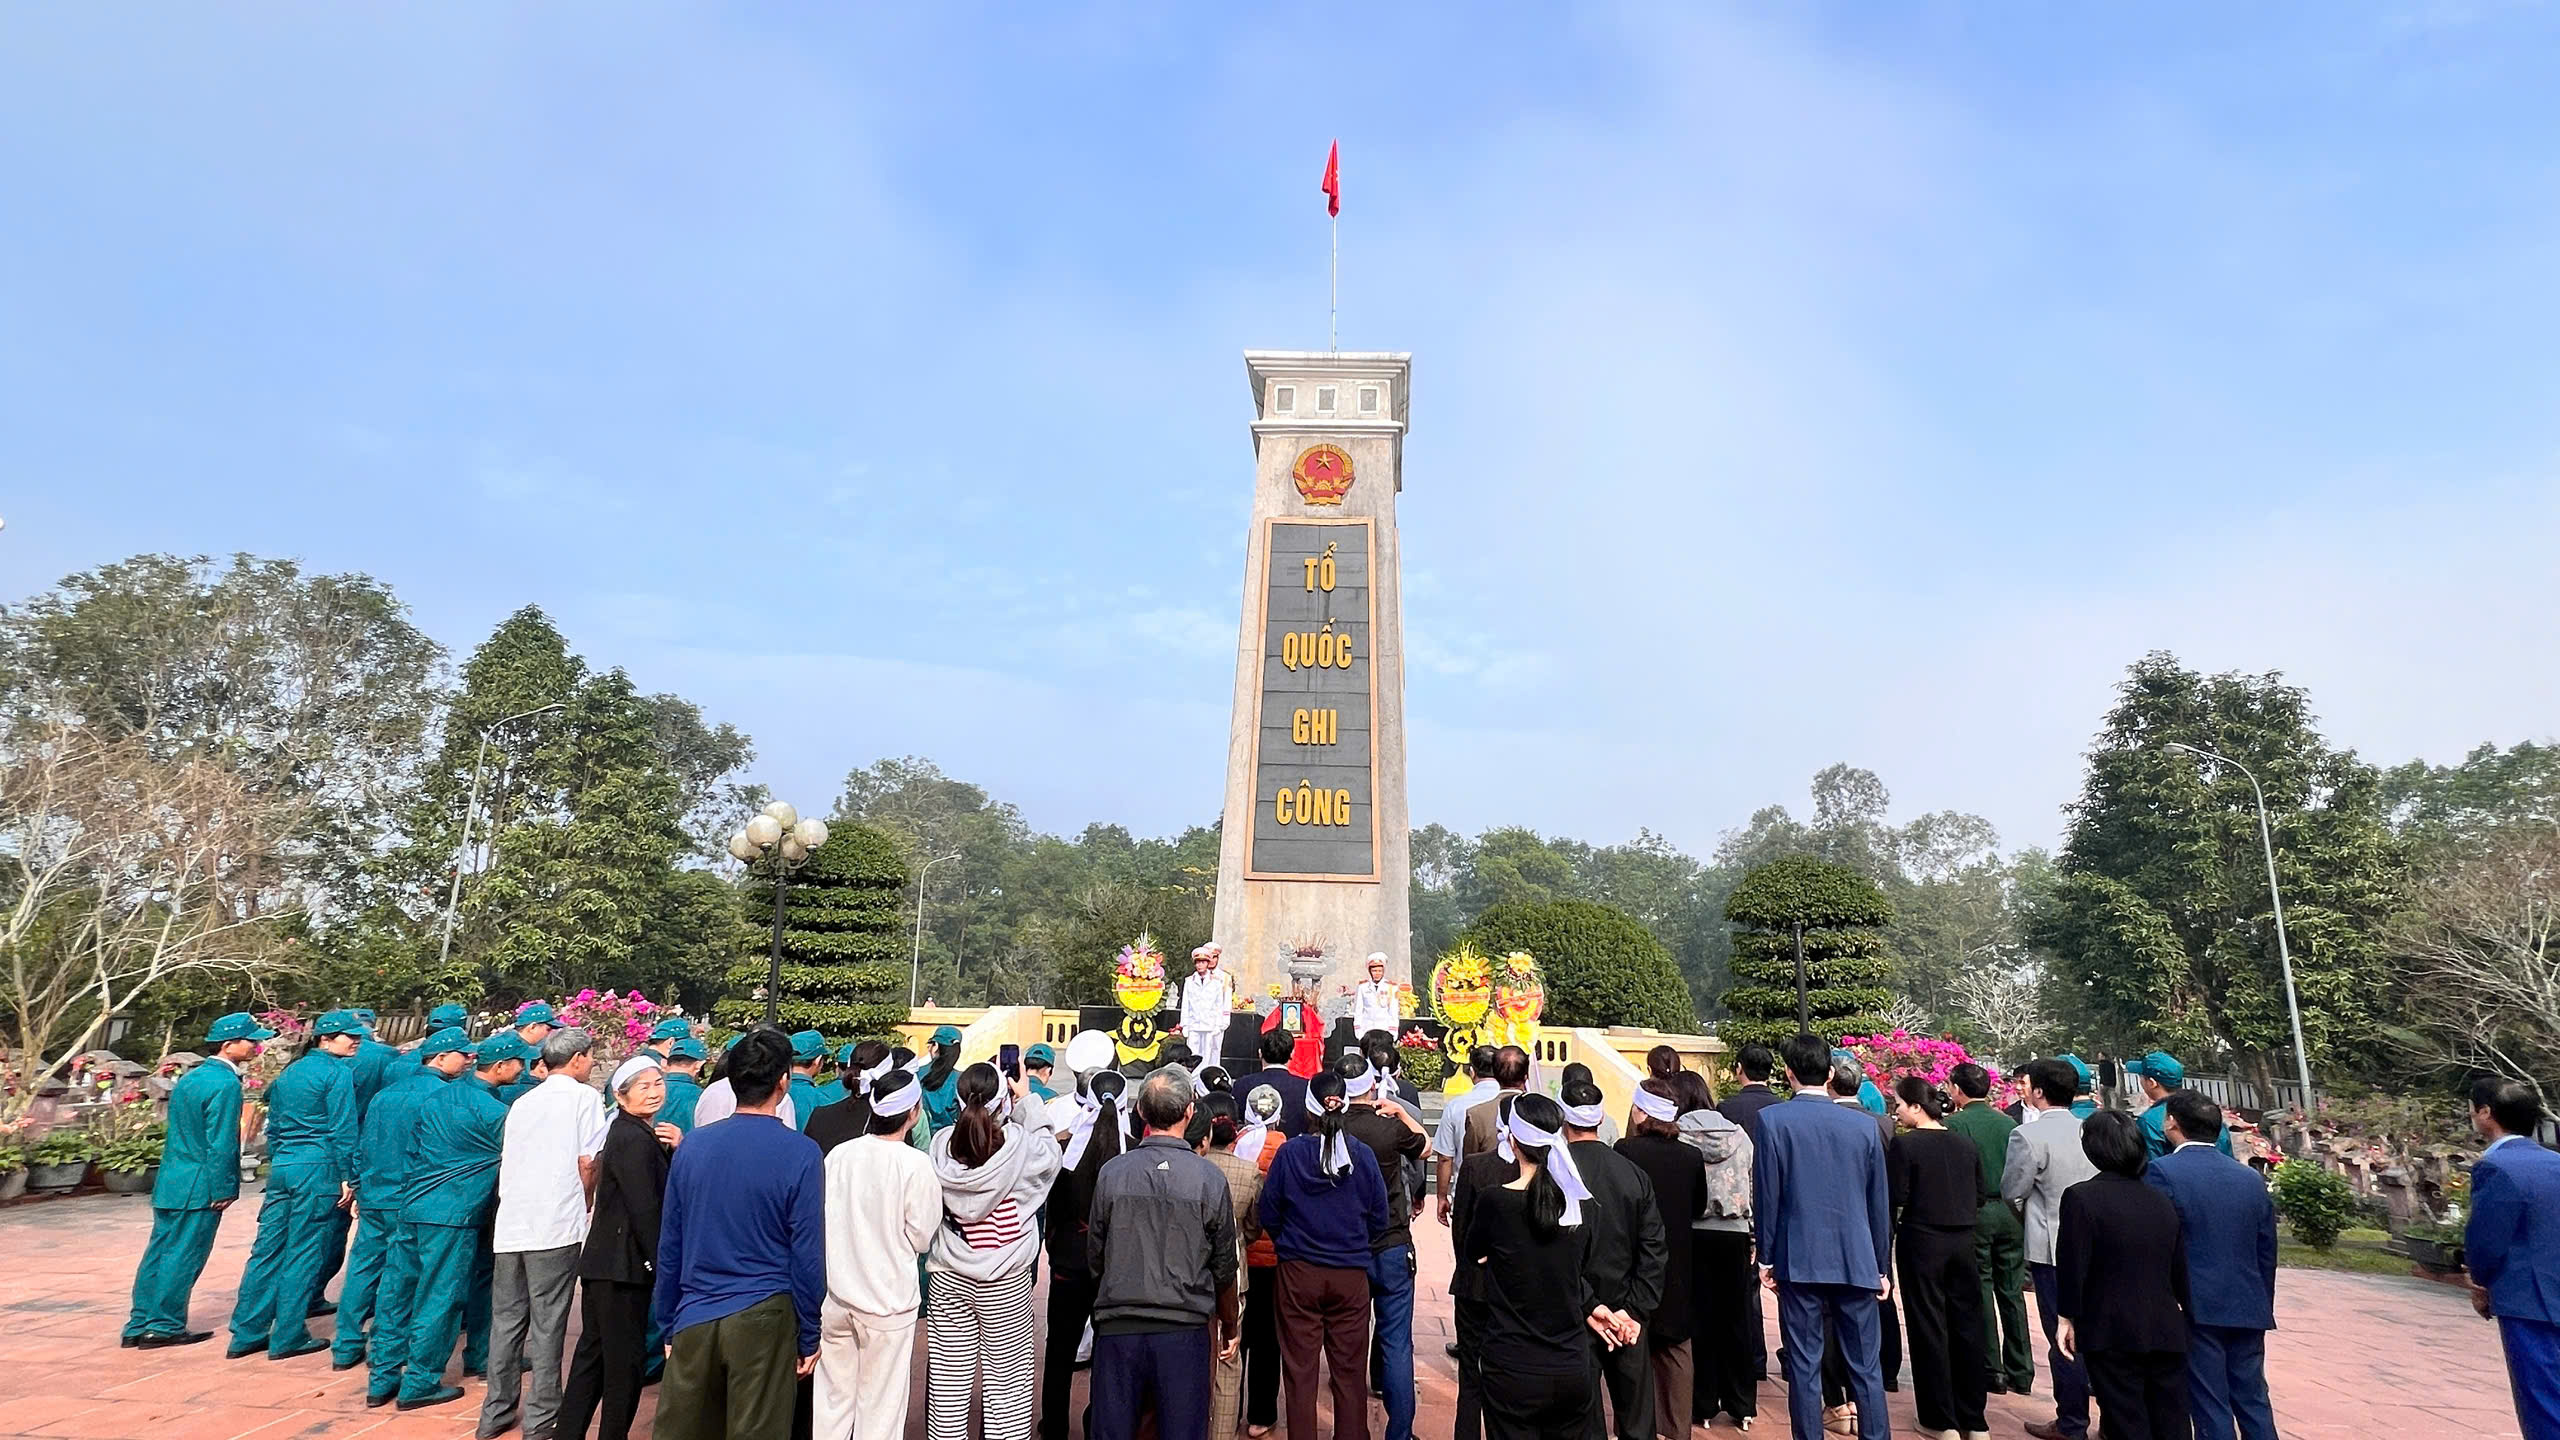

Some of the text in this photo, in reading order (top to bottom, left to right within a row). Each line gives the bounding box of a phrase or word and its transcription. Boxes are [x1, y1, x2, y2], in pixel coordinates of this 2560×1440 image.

[1304, 541, 1337, 592] TỔ
[1283, 617, 1352, 672] QUỐC
[1292, 708, 1337, 745] GHI
[1276, 779, 1351, 826] CÔNG
